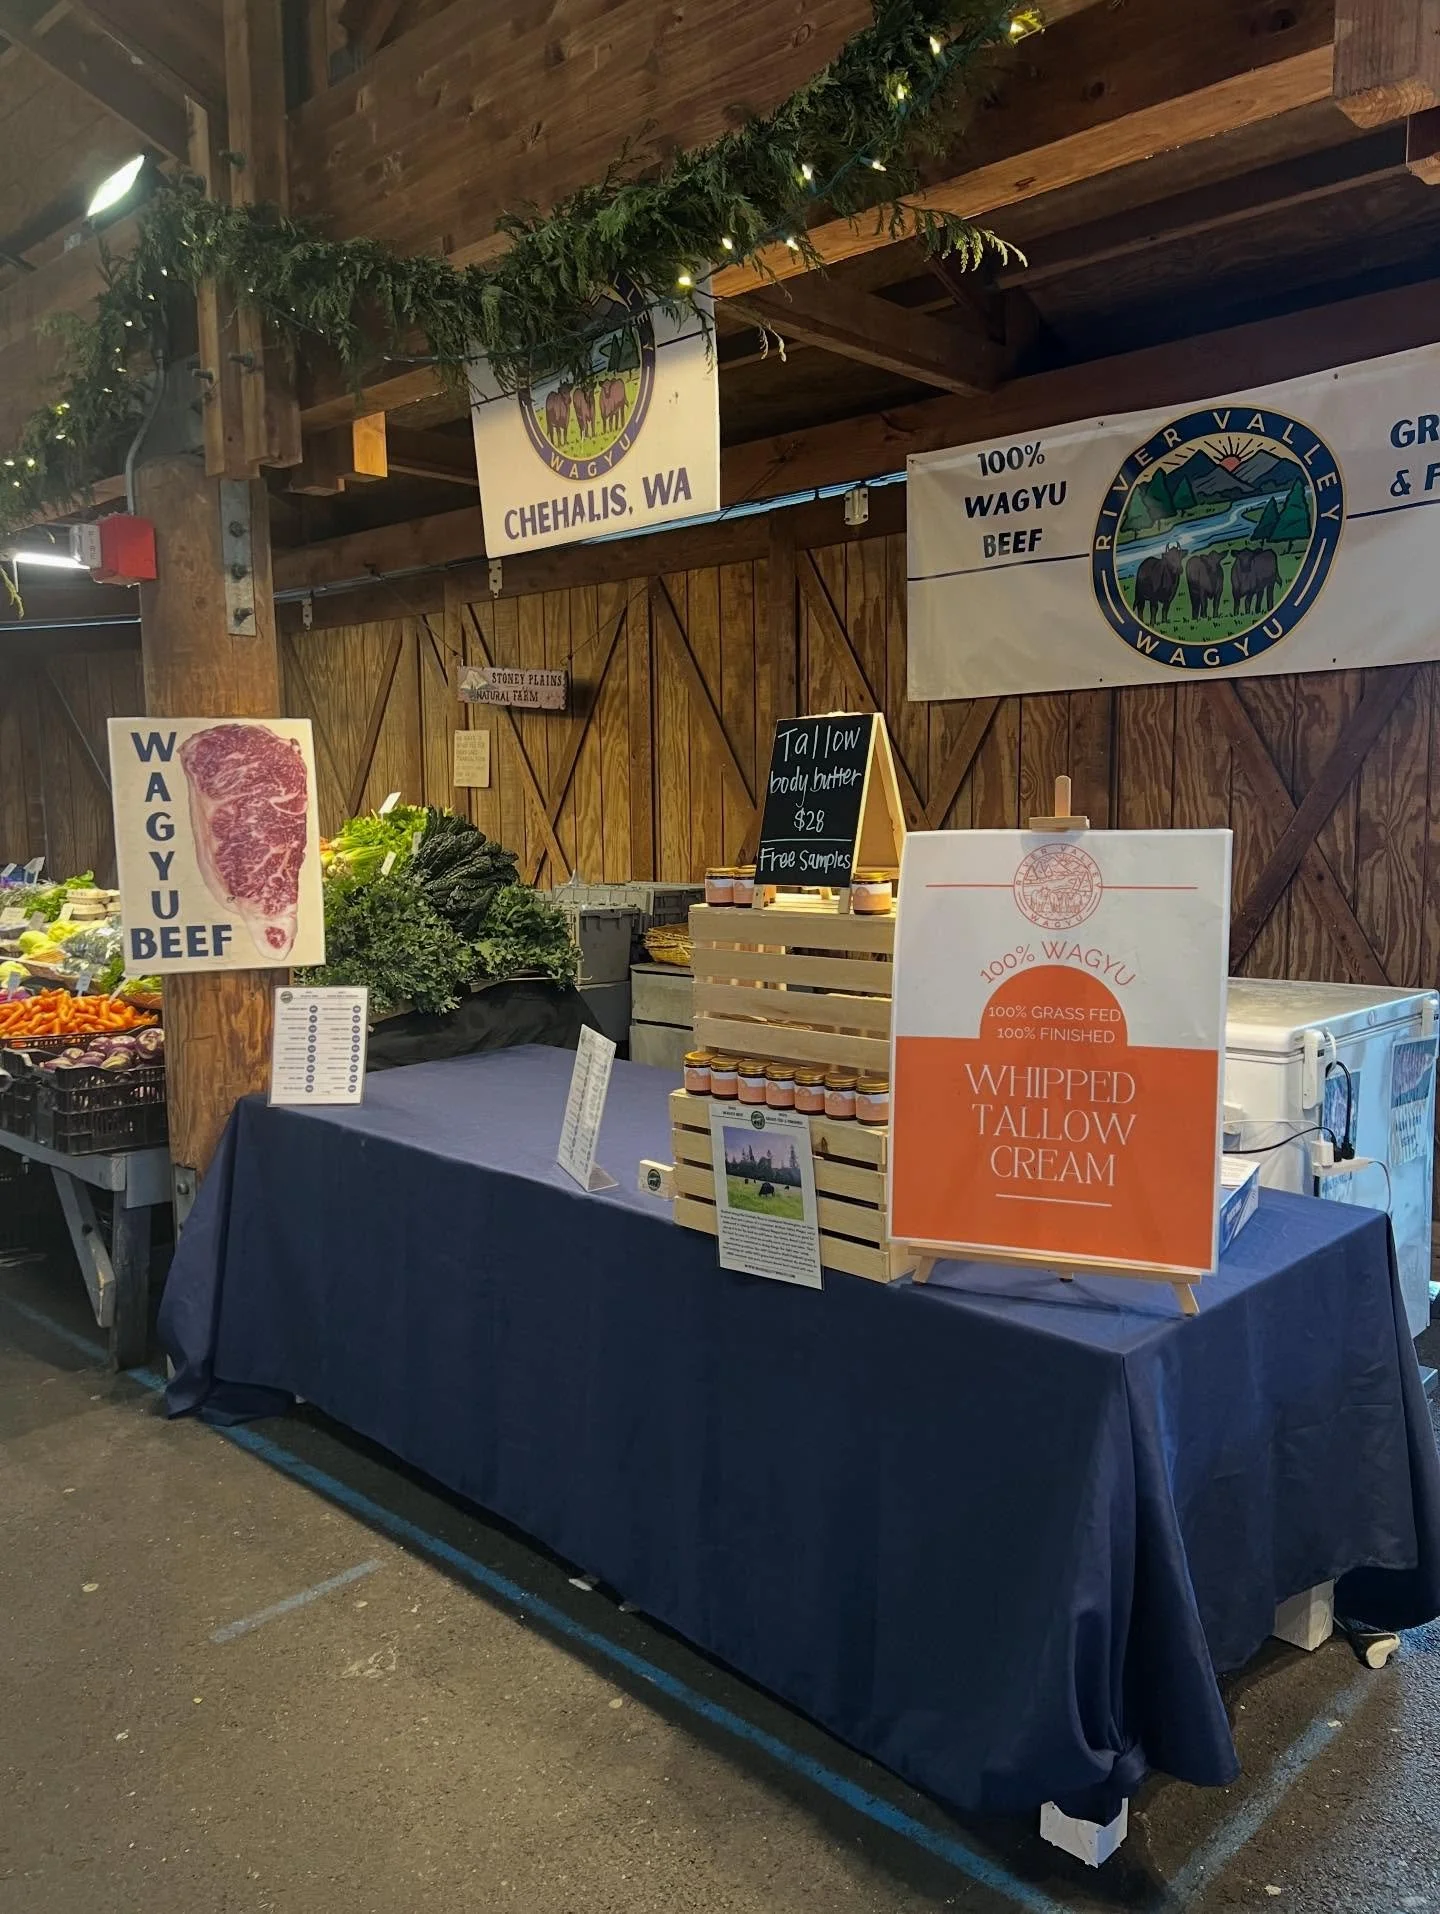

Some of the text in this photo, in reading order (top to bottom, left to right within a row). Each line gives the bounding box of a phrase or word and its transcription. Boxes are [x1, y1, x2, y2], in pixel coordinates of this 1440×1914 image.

[549, 433, 631, 479] WAGYU
[978, 441, 1045, 477] 100%
[965, 480, 1067, 519] WAGYU
[1096, 411, 1340, 550] RIVER VALLEY
[1390, 469, 1411, 497] &
[504, 466, 692, 540] CHEHALIS, WA
[983, 528, 1043, 559] BEEF
[1136, 618, 1284, 666] WAGYU
[476, 690, 538, 702] NATURAL FARM
[491, 672, 562, 687] STONEY PLAINS
[778, 724, 861, 762] Tallow
[769, 766, 862, 808] body butter
[130, 731, 179, 920] WAGYU
[793, 807, 825, 833] $28
[760, 847, 795, 872] Free
[1015, 845, 1101, 888] RIVER VALLEY
[1030, 914, 1083, 928] WAGYU
[130, 924, 232, 960] BEEF
[980, 941, 1136, 986] 100% WAGYU
[988, 1004, 1121, 1022] 100% GRASS FED
[996, 1027, 1116, 1044] 100% FINISHED
[964, 1063, 1136, 1104] WHIPPED
[972, 1103, 1137, 1145] TALLOW
[990, 1145, 1116, 1187] CREAM
